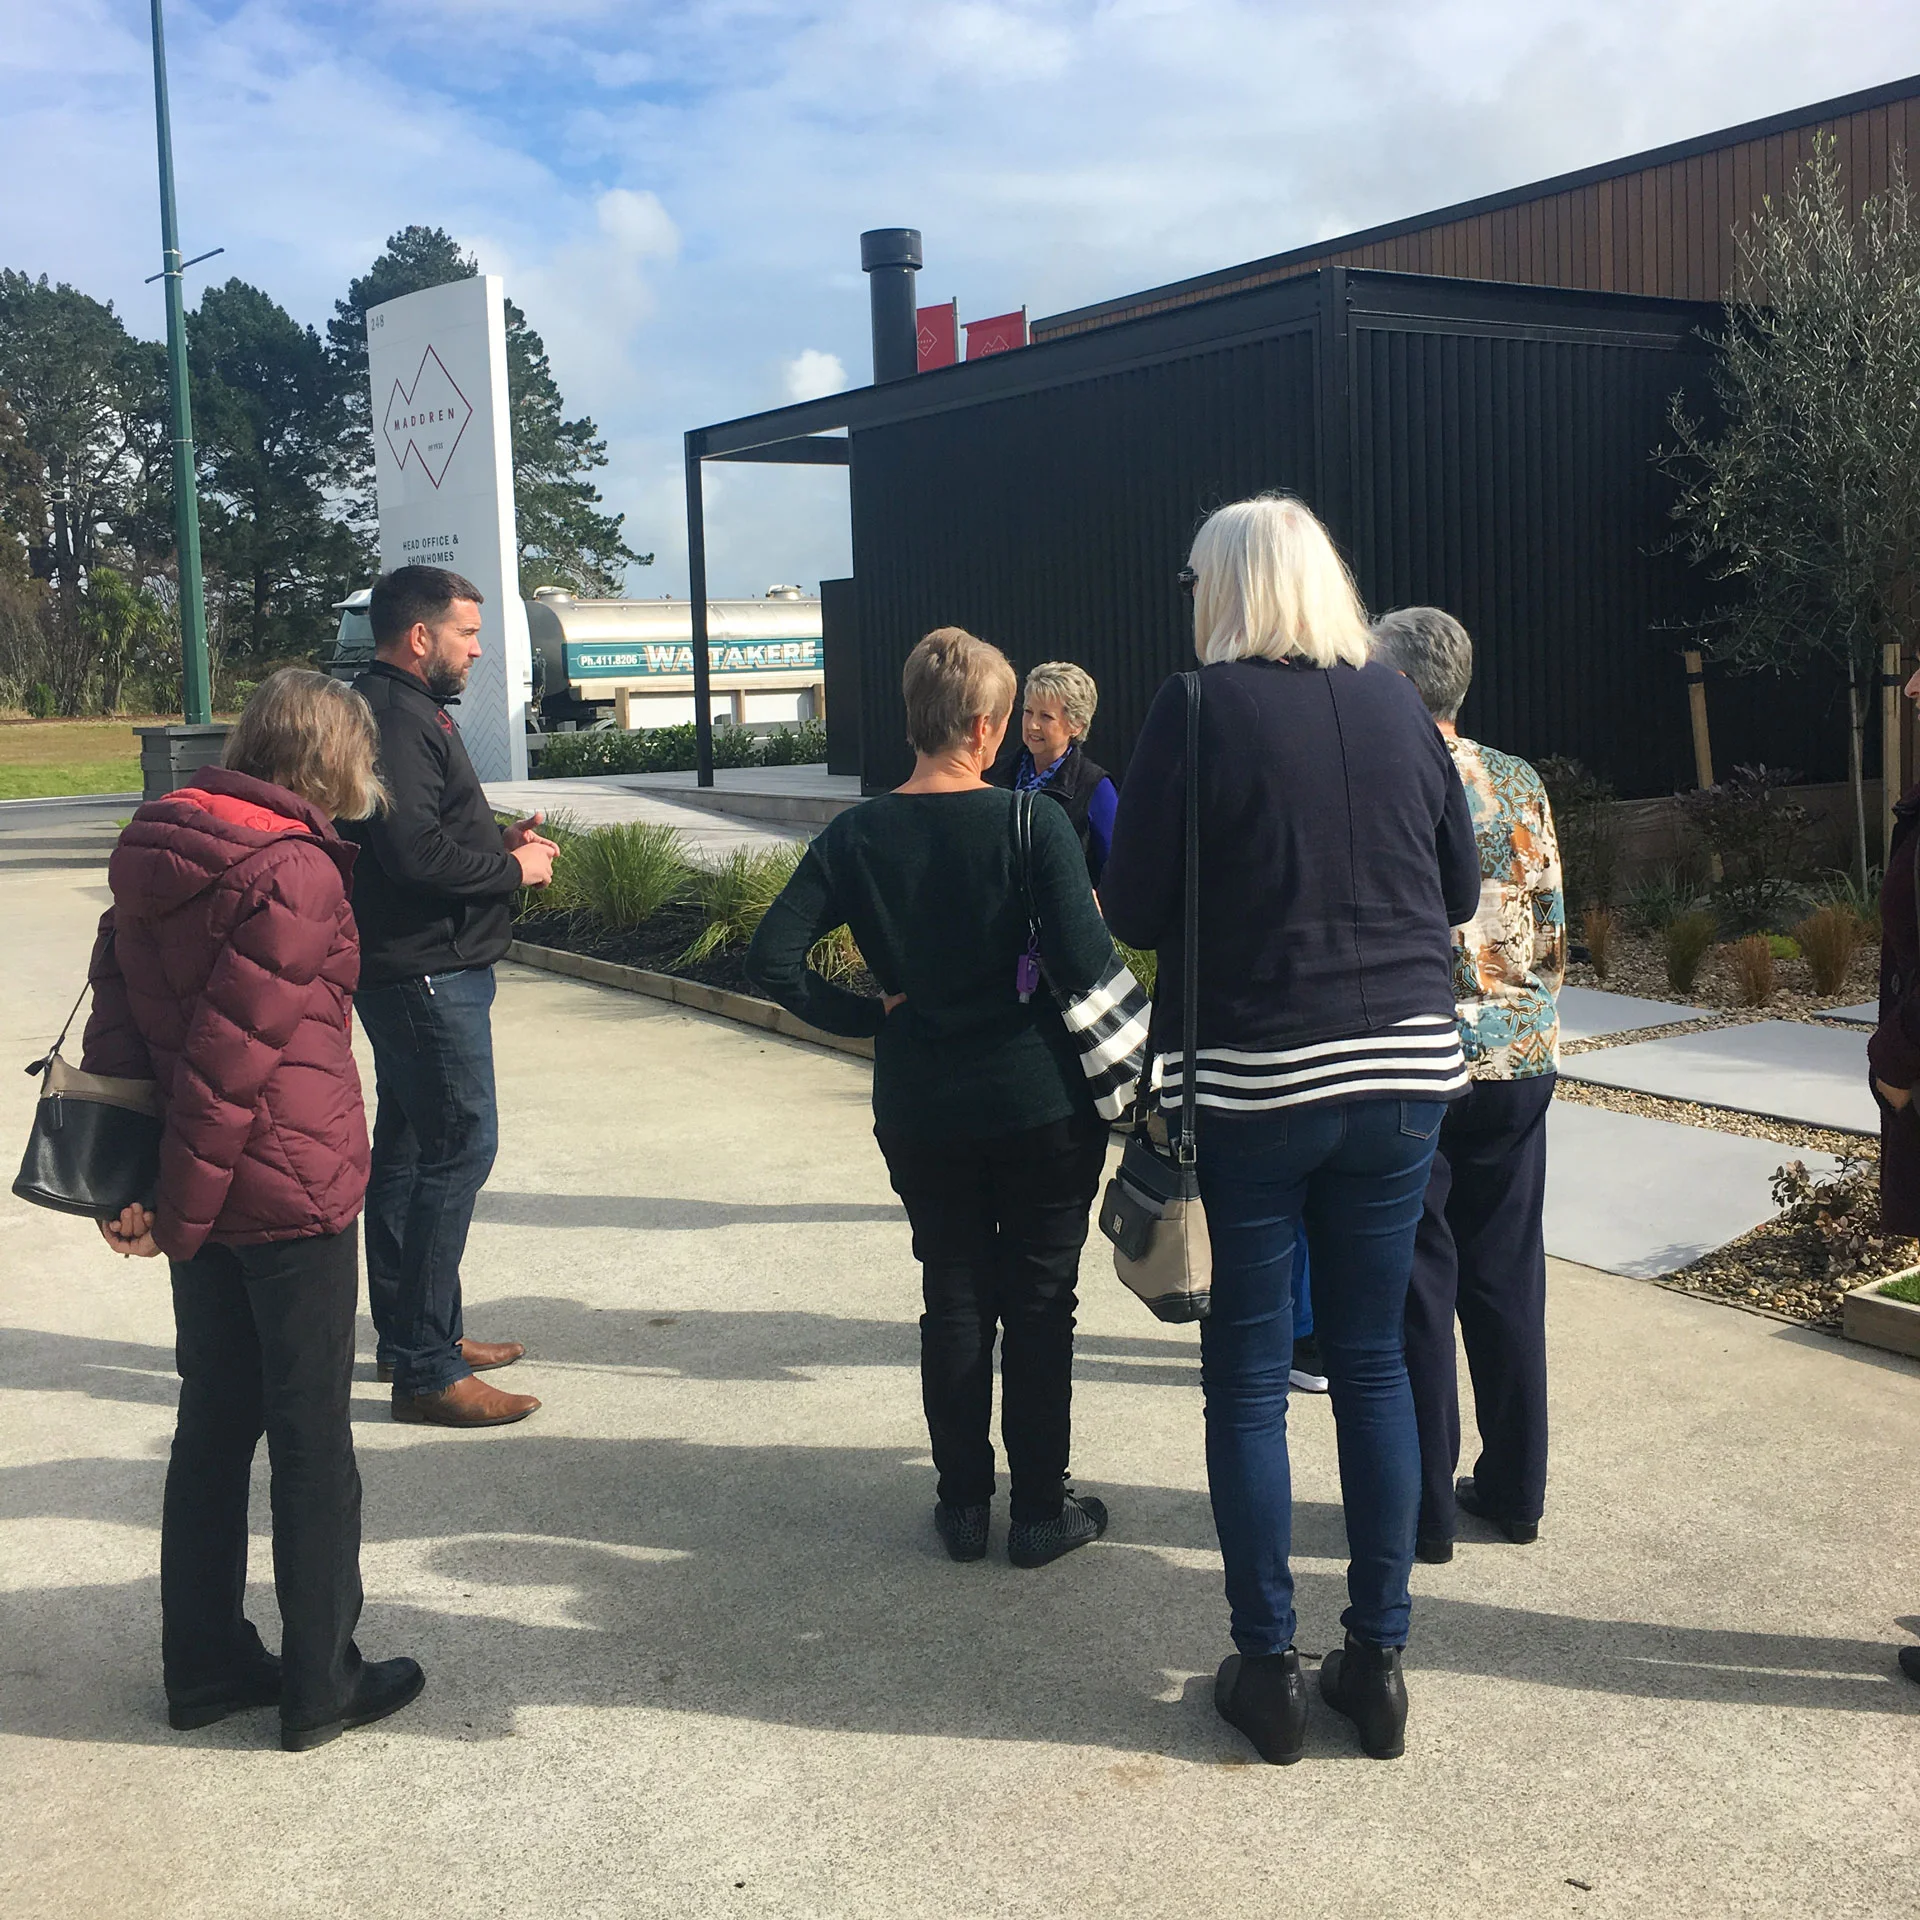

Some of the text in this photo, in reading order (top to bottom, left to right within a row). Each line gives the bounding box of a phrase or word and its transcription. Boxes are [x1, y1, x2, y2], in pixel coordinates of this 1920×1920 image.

[371, 314, 384, 331] 248
[394, 407, 455, 431] MADDREN
[402, 534, 459, 551] HEAD OFFICE &
[407, 551, 454, 566] SHOWHOMES
[580, 641, 817, 672] Ph.411.8206 WATAKERE
